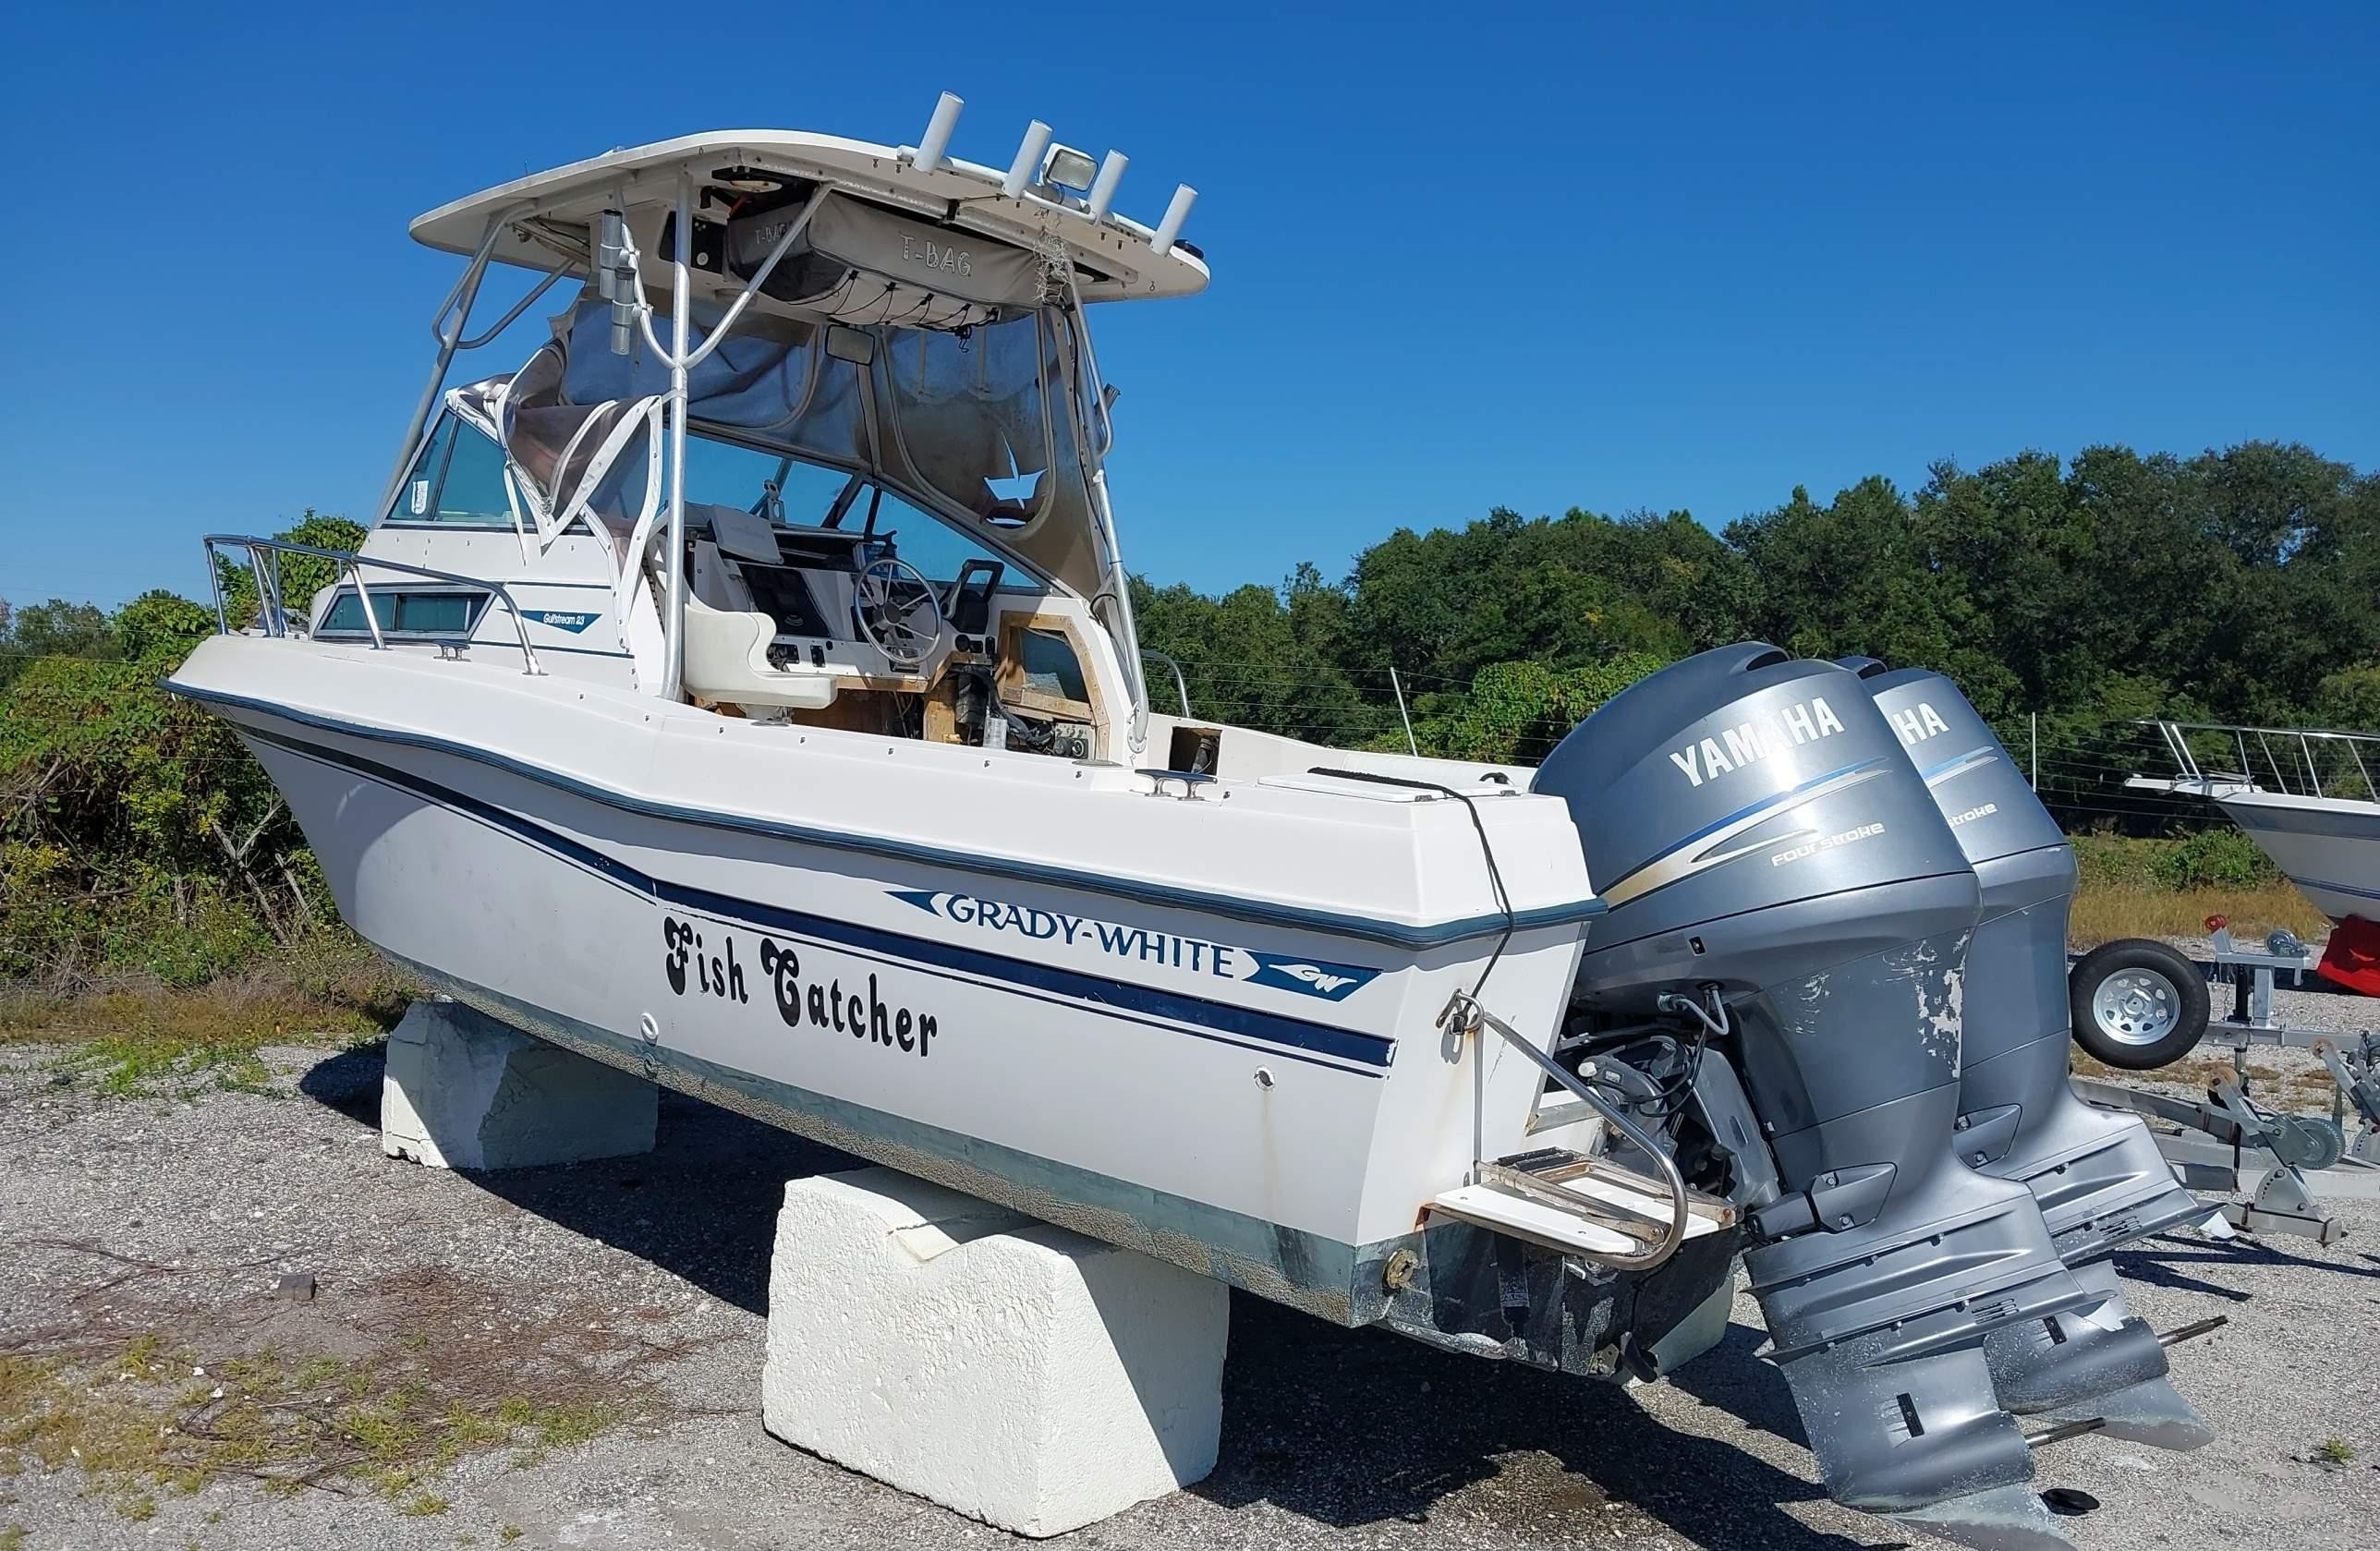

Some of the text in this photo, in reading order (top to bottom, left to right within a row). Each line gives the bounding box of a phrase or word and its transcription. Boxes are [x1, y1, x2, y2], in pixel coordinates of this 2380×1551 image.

[901, 235, 972, 276] T-BAG
[576, 615, 585, 625] 23
[1669, 697, 1846, 788] YAMAHA
[1948, 803, 1998, 828] stroke
[945, 893, 1235, 978] GRADY-WHITE
[663, 915, 938, 1058] Fish Catcher
